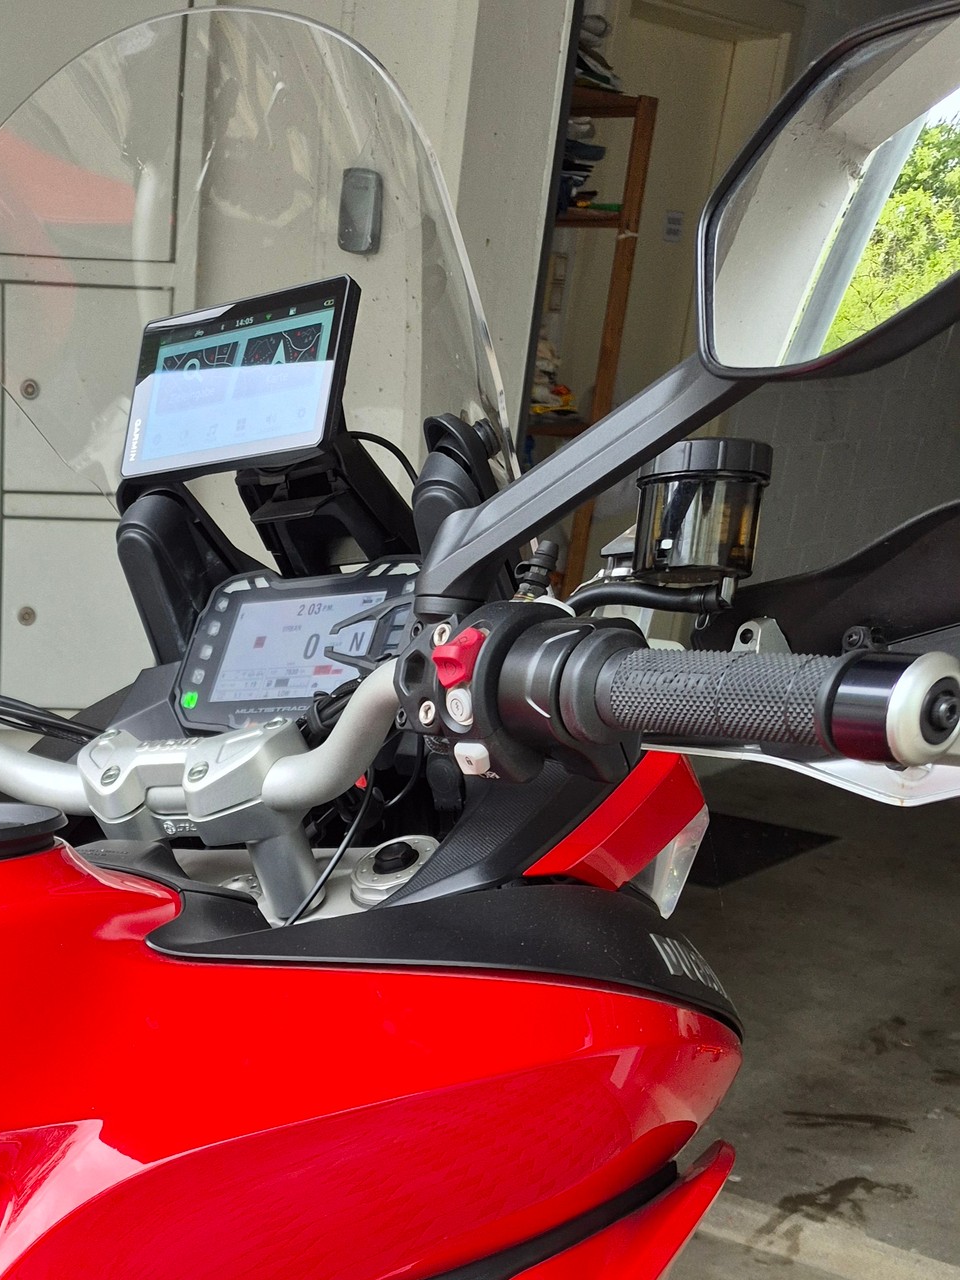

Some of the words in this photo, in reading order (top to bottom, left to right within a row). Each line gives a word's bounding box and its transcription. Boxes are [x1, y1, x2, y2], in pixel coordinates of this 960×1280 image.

[129, 418, 142, 462] GARMIN
[349, 631, 366, 652] N
[625, 670, 709, 693] DUCATI
[235, 705, 312, 715] MULTISTRAD
